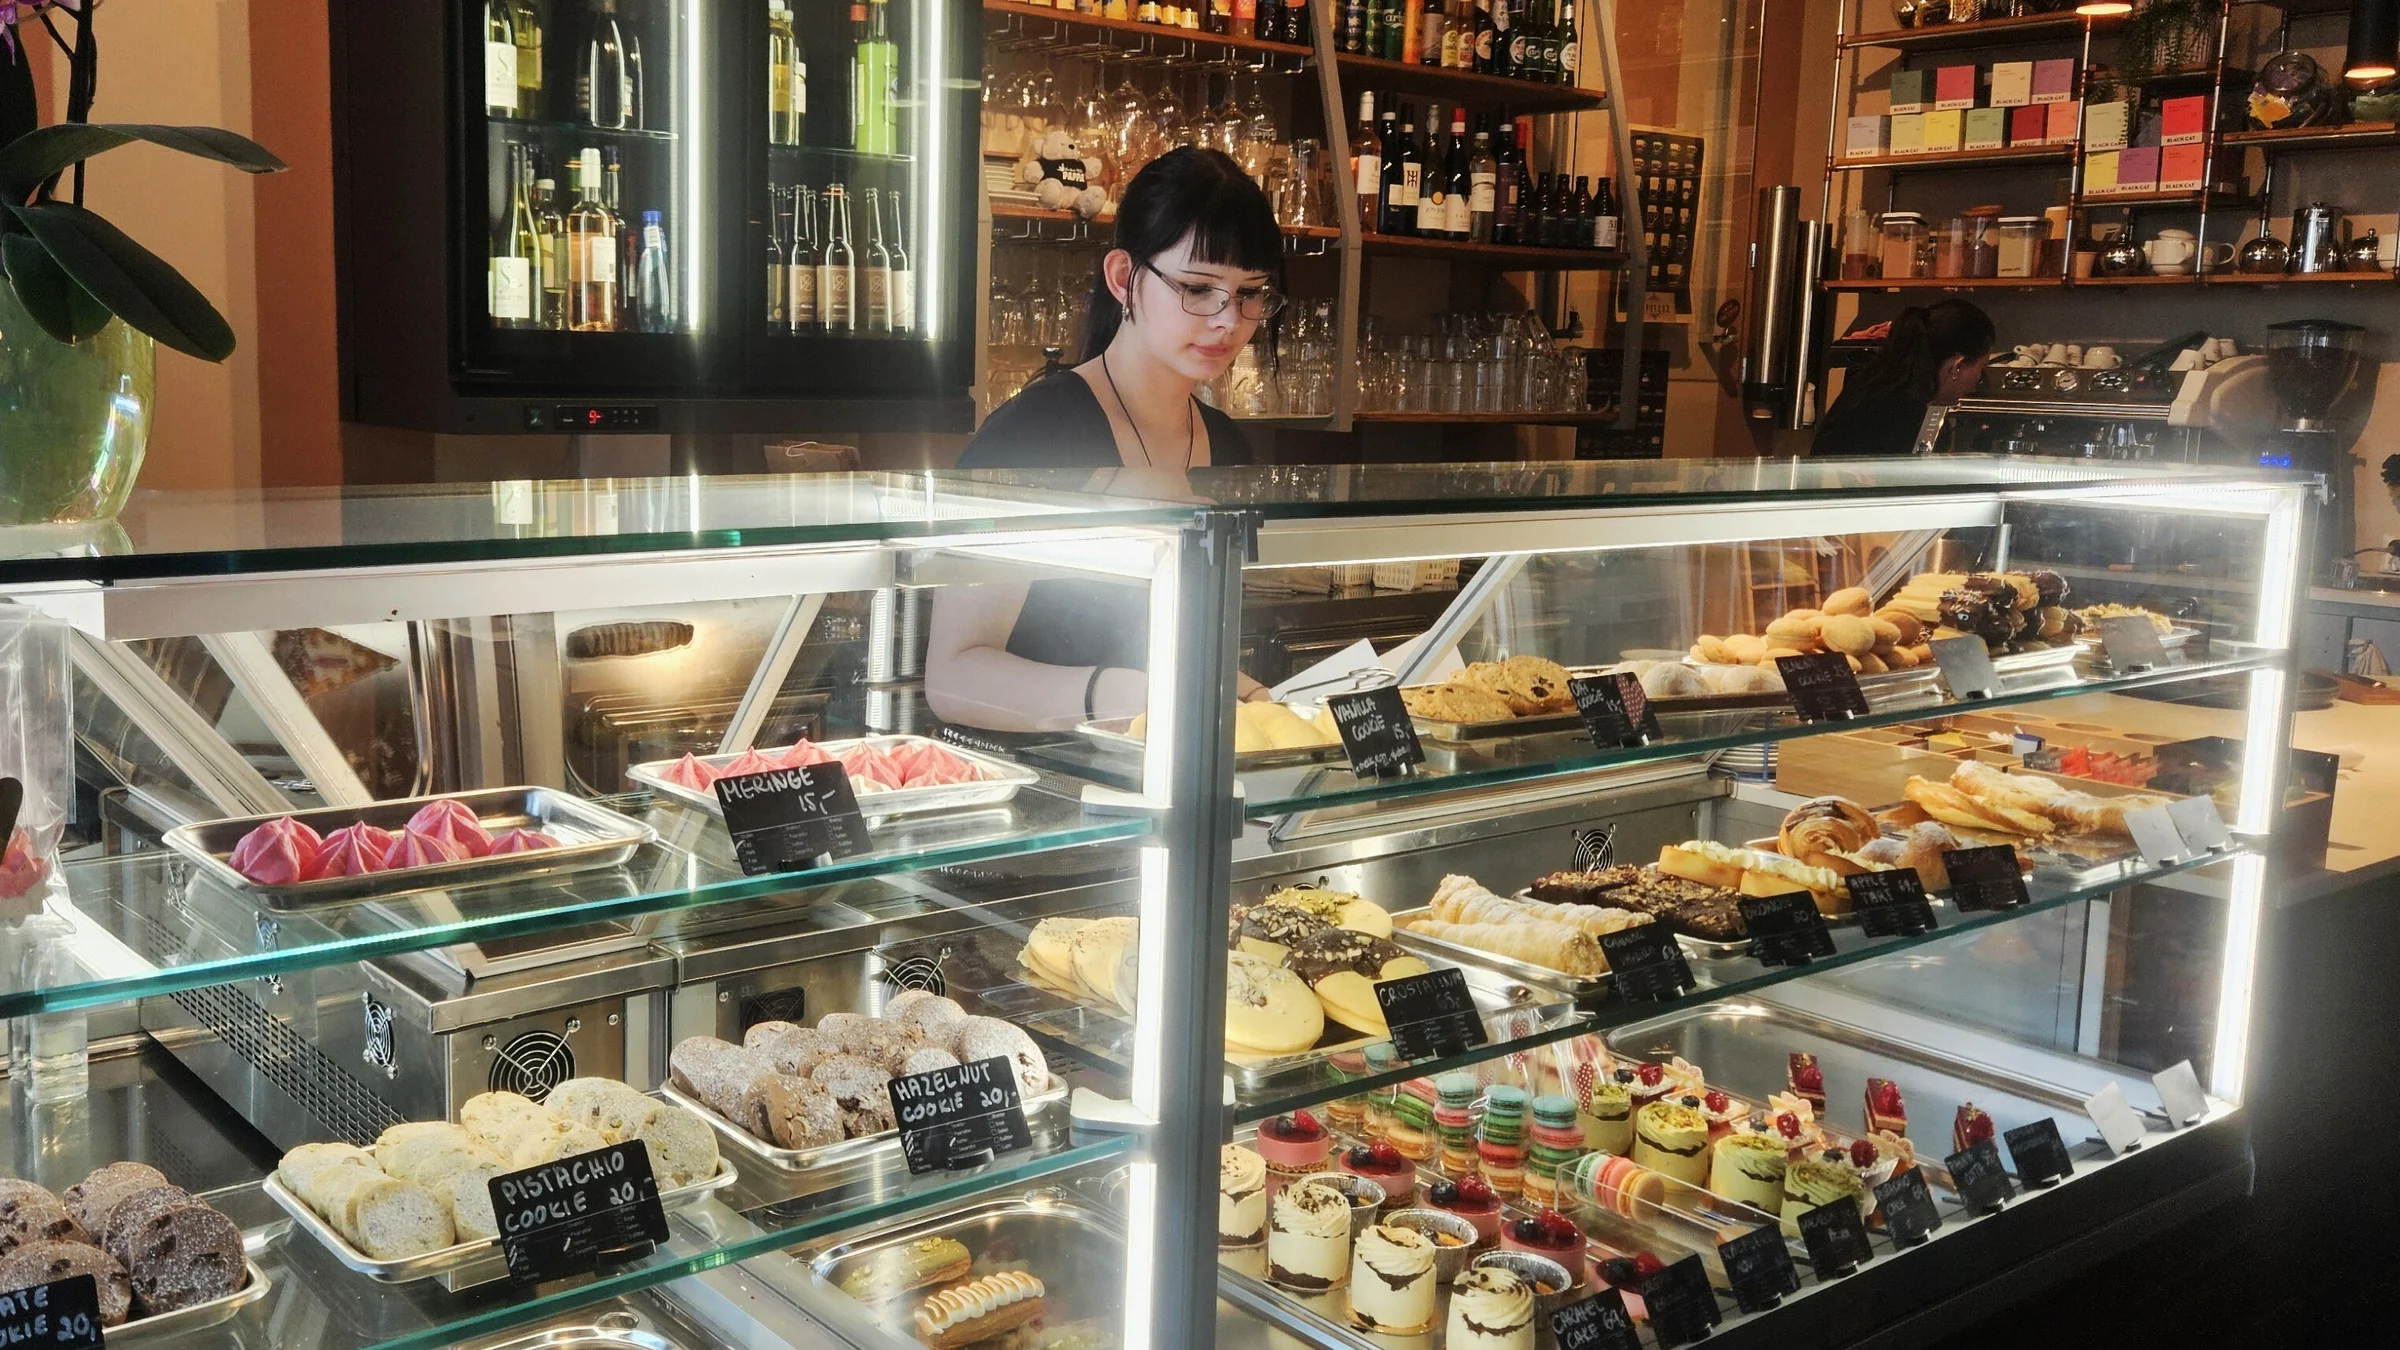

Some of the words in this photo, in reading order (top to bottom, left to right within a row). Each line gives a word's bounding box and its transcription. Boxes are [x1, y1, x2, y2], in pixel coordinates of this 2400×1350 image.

[902, 1091, 964, 1122] COOKIE
[501, 1151, 624, 1205] PISTACHIO
[505, 1190, 587, 1232] COOKIE
[1566, 1322, 1600, 1349] CAKE
